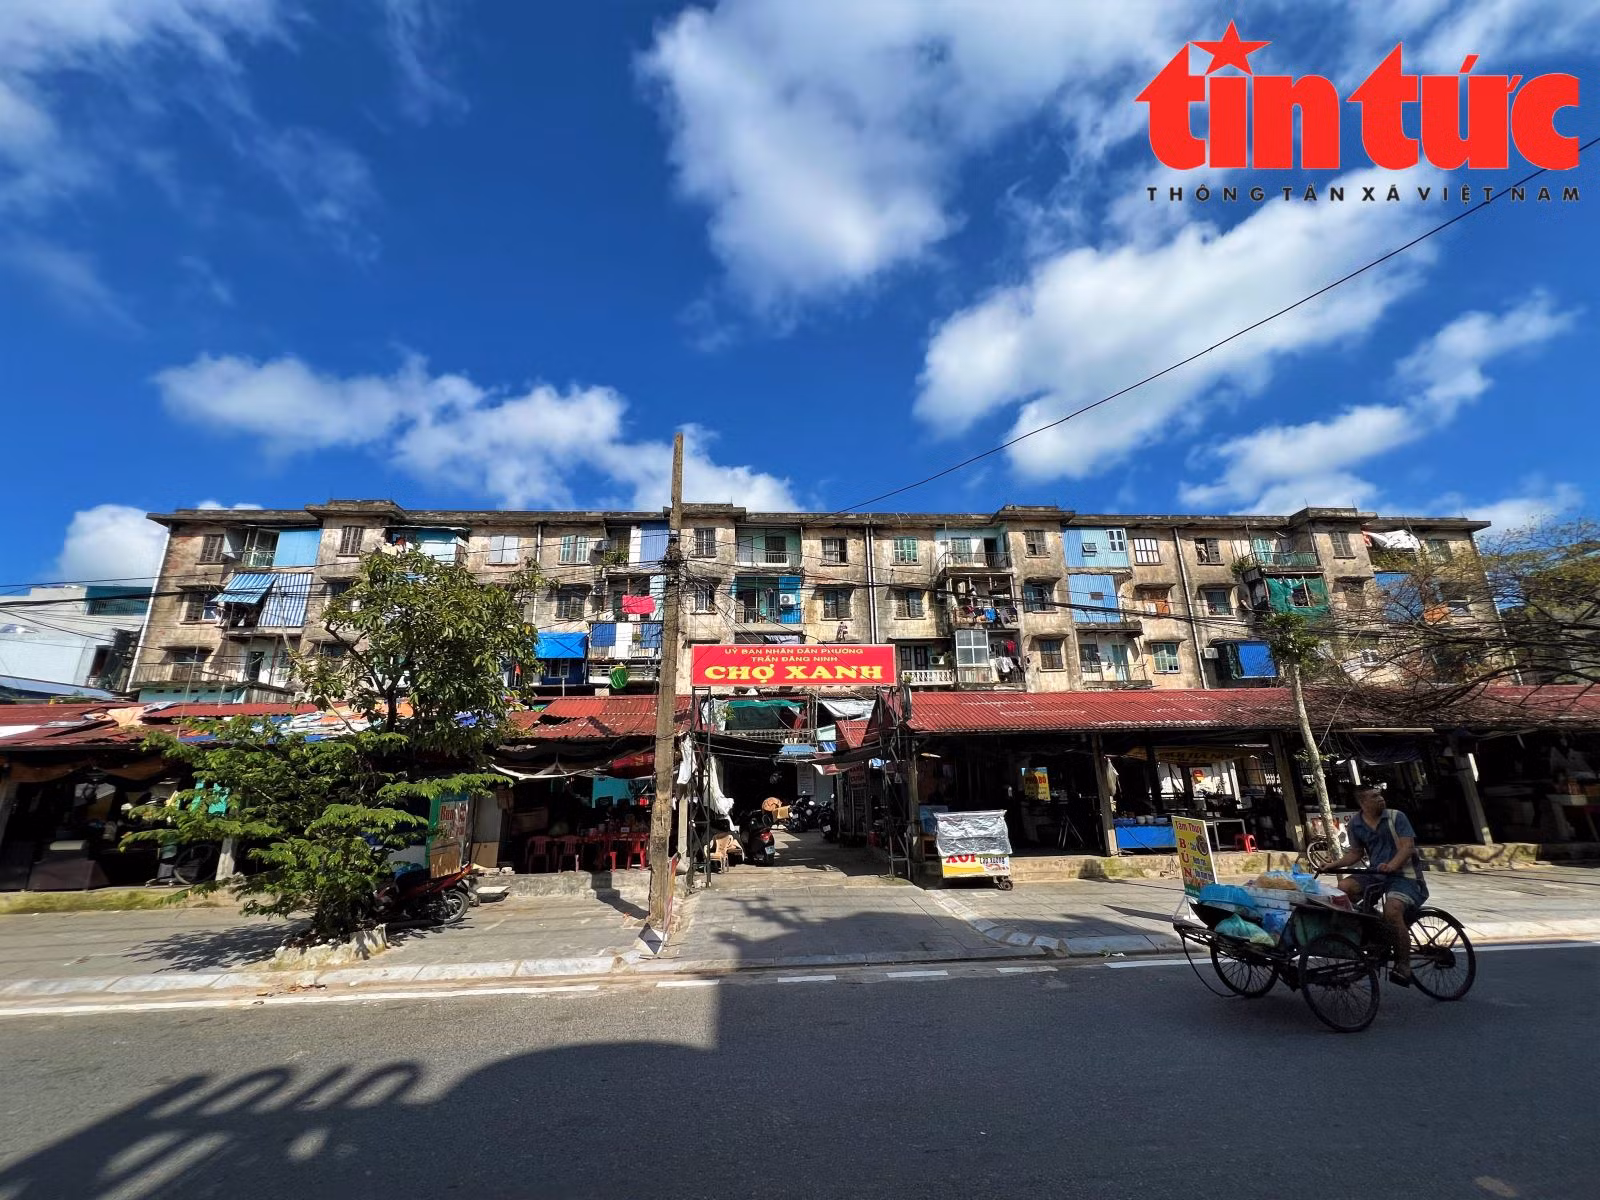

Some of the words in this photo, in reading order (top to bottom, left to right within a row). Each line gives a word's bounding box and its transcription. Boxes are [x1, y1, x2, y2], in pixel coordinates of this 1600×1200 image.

[765, 647, 794, 655] NHÂN
[796, 647, 818, 655] DÂN
[704, 663, 775, 684] CHỢ
[784, 665, 883, 680] XANH
